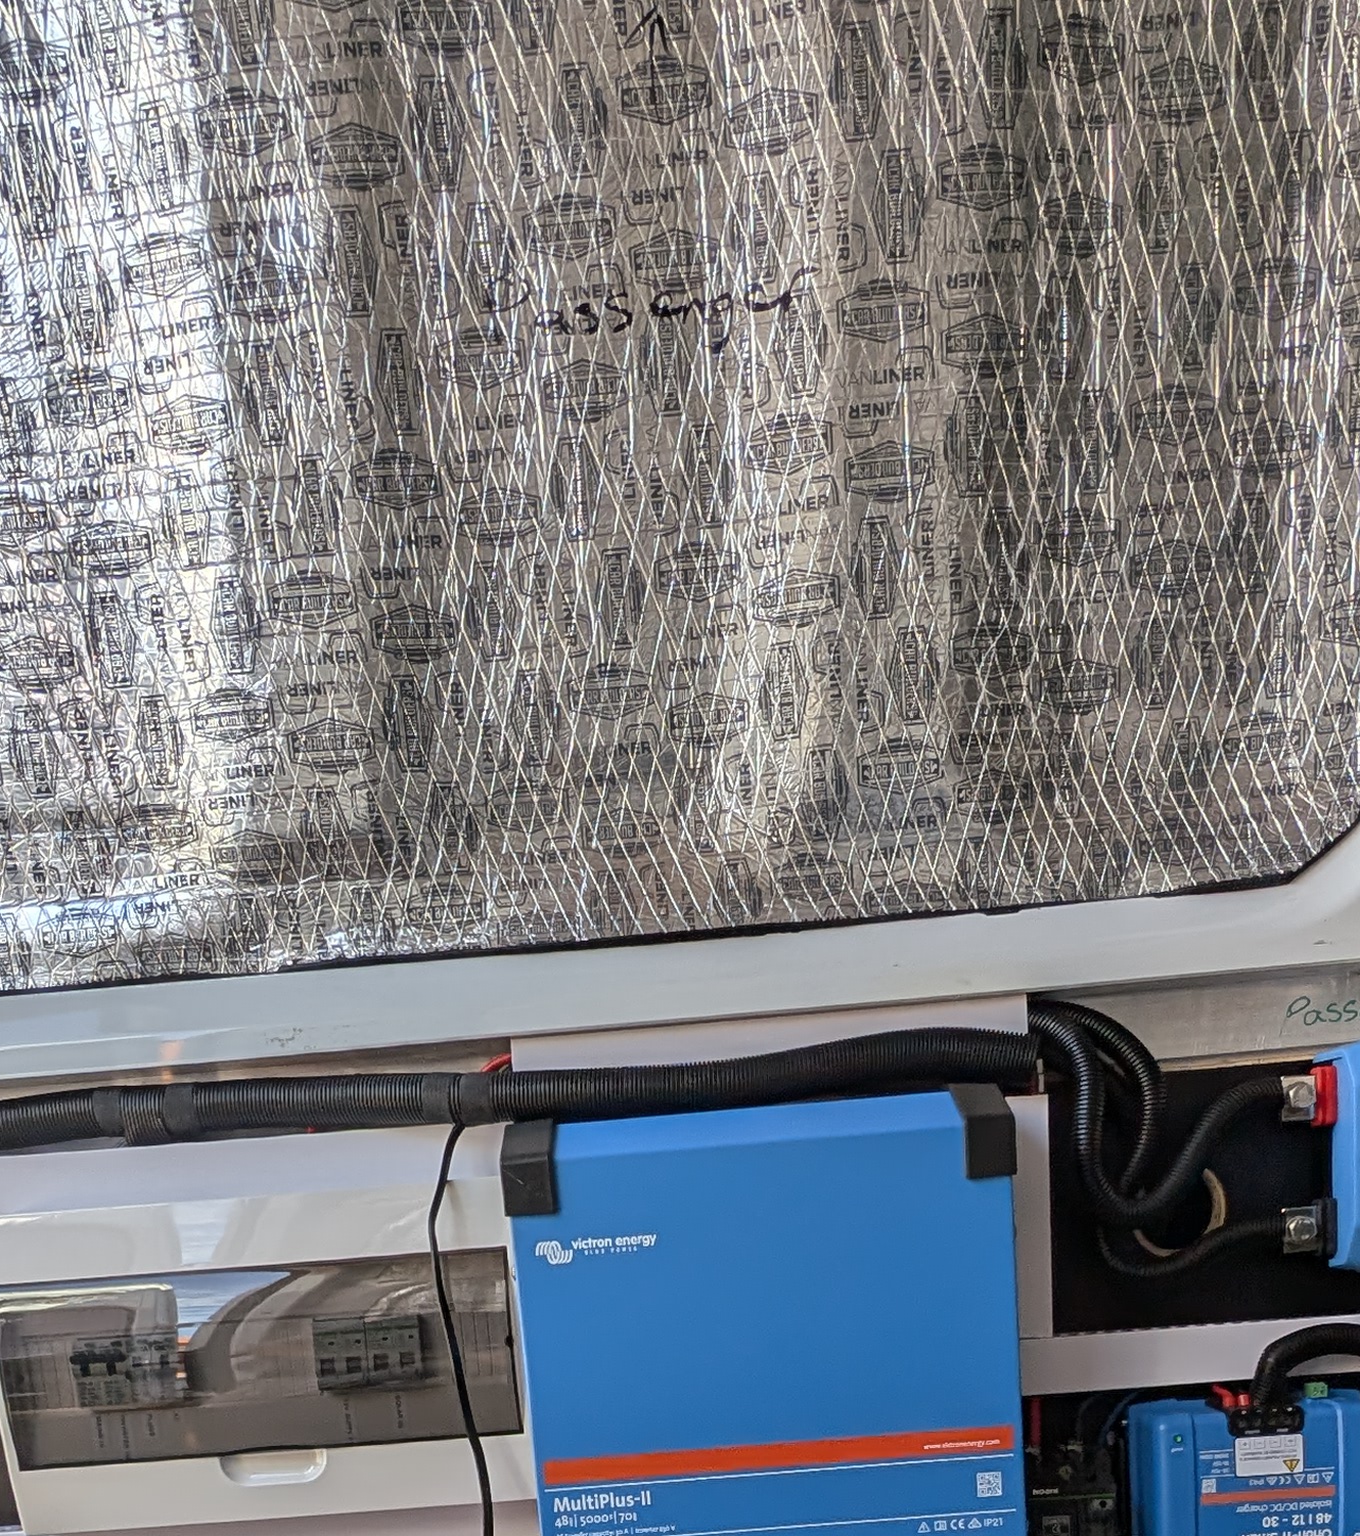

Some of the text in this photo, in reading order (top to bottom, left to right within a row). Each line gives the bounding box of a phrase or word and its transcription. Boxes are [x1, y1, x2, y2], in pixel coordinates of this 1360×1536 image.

[851, 307, 871, 325] CAR
[571, 1233, 657, 1250] victron energy
[553, 1490, 652, 1513] MultiPlus-II
[1235, 1503, 1269, 1514] charger
[1269, 1501, 1298, 1512] DC/DC
[983, 1517, 1003, 1528] IP21
[1262, 1513, 1332, 1527] 48 12 30
